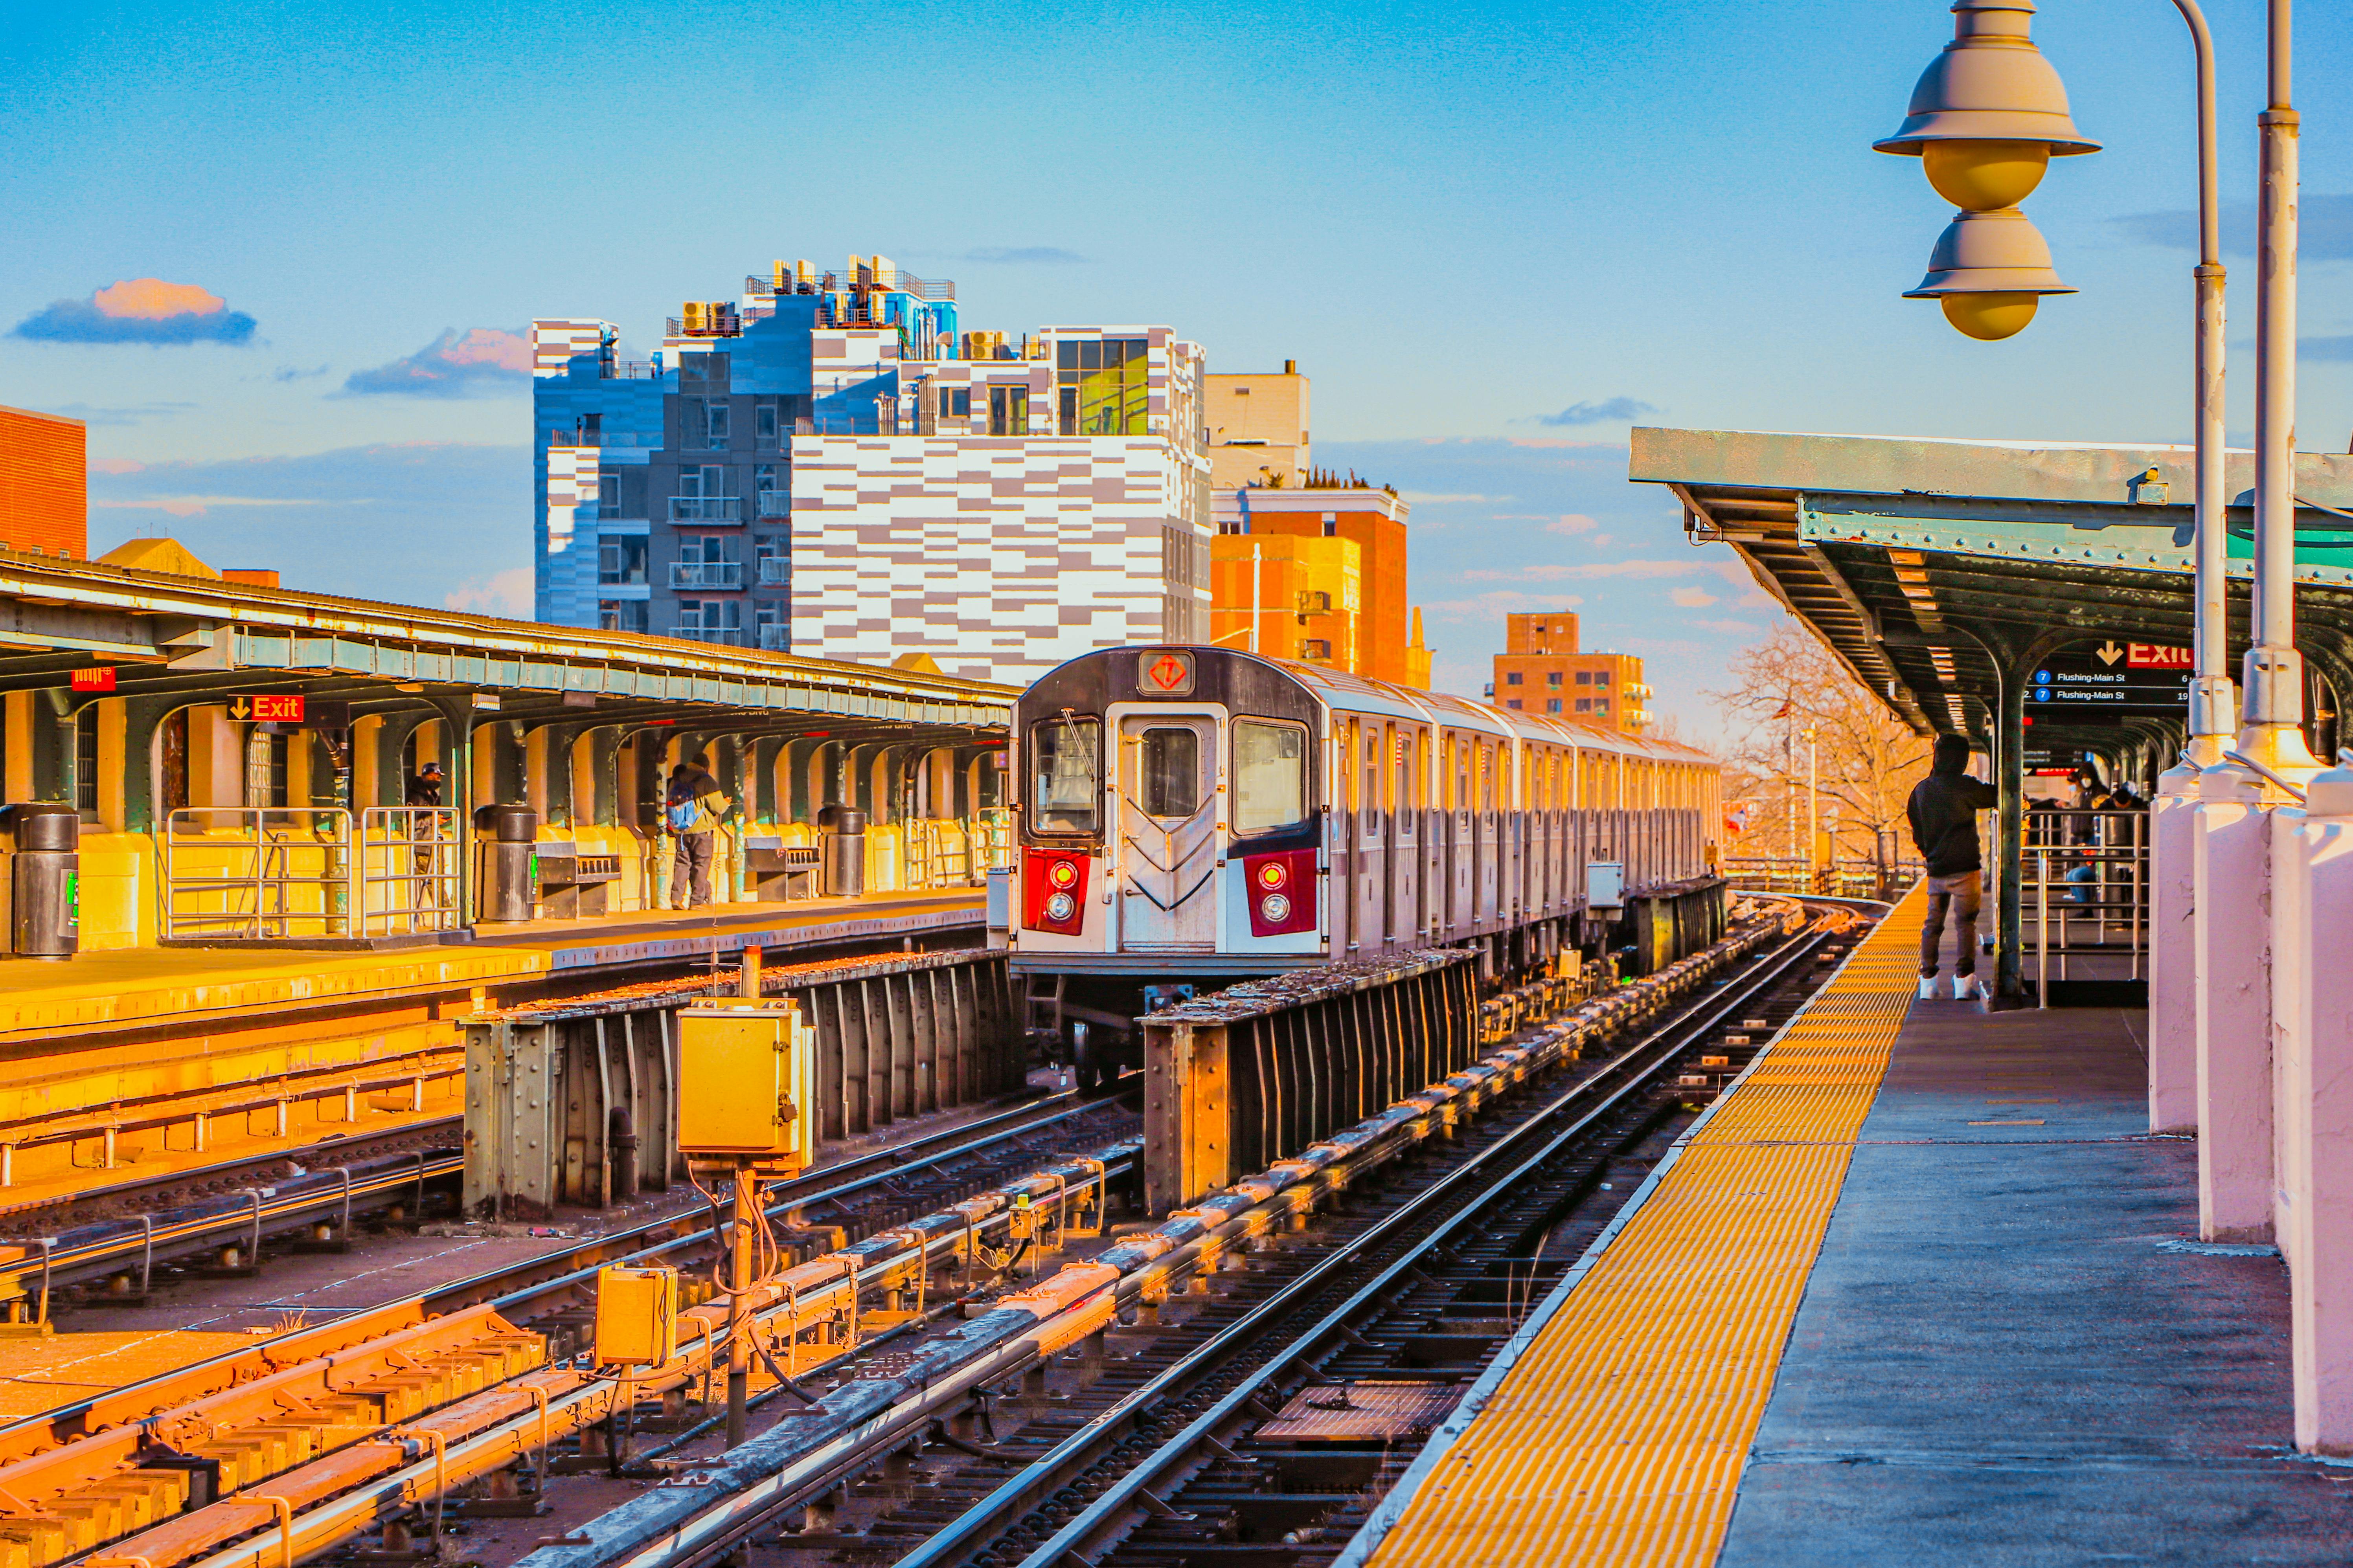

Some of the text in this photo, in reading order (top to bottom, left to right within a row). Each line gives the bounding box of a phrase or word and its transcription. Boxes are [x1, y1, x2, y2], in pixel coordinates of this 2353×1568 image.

[2129, 643, 2191, 663] Exit
[1162, 662, 1174, 682] 7
[2057, 673, 2114, 683] Flushing-Main
[2057, 691, 2114, 700] Flushing-Main
[254, 697, 298, 717] Exit
